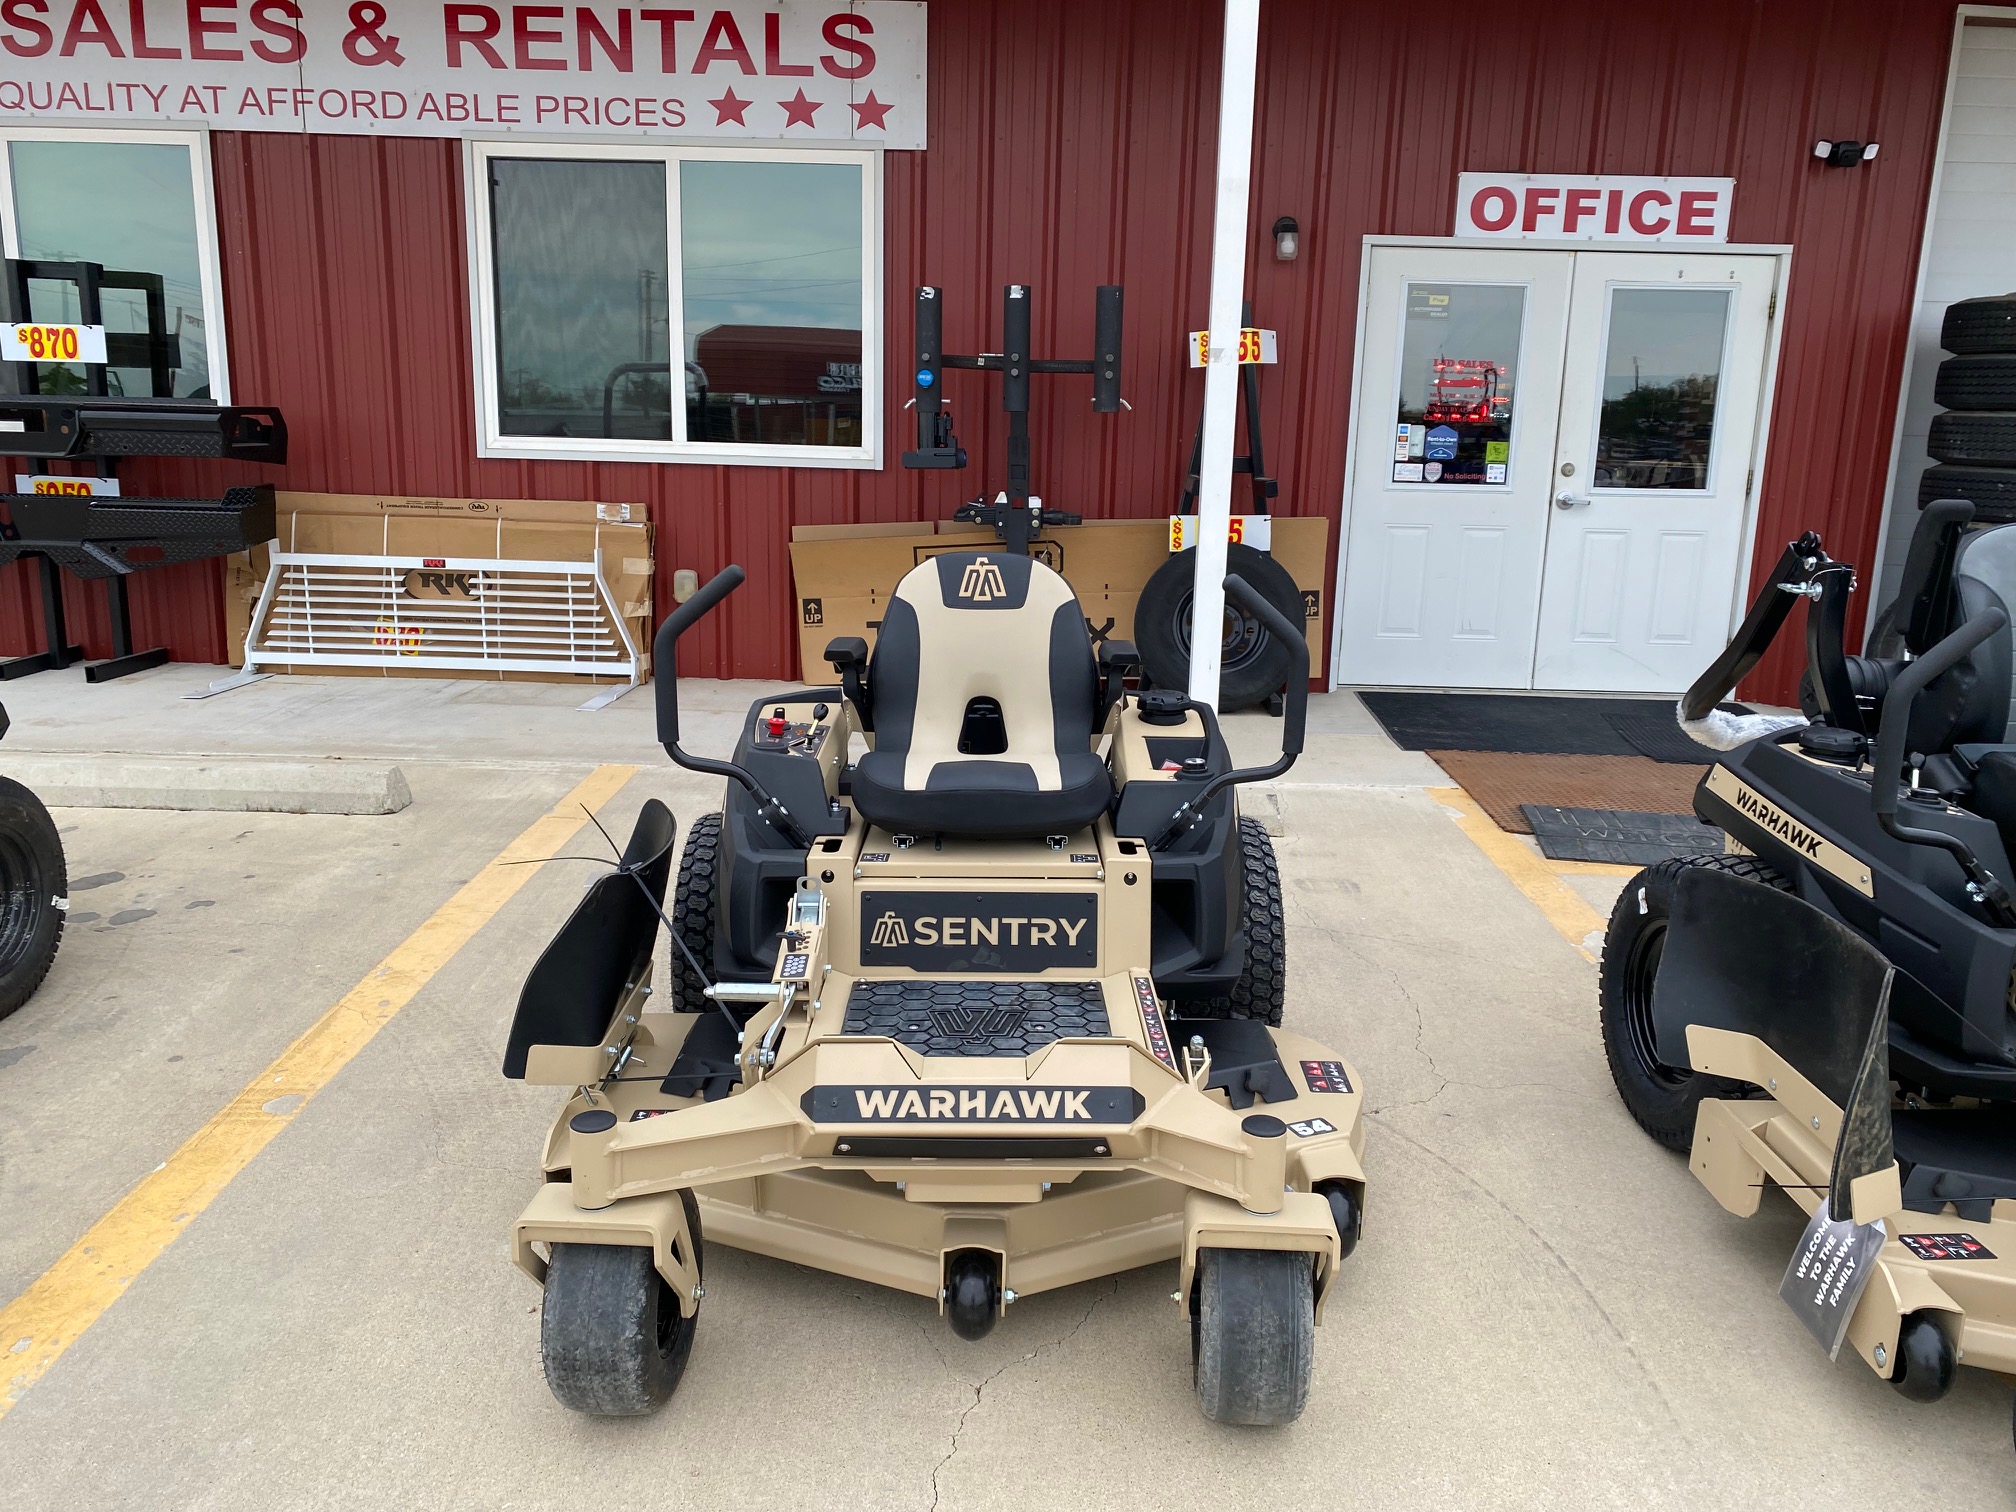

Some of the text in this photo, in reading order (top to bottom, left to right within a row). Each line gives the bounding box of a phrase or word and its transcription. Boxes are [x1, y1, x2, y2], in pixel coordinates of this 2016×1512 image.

[0, 0, 877, 80] SALES & RENTALS
[0, 81, 168, 112] QUALITY
[179, 85, 228, 114] AT
[535, 95, 686, 127] PRICES
[1470, 186, 1719, 236] OFFICE
[18, 326, 78, 359] $870
[1455, 473, 1486, 481] Soliciting
[805, 613, 822, 623] UP
[1736, 787, 1823, 859] WARHAWK
[914, 916, 1088, 946] SENTRY
[854, 1089, 1092, 1119] WARHAWK
[1289, 1119, 1333, 1136] 54
[1796, 1214, 1832, 1279] WELCOME
[1809, 1234, 1837, 1281] TO THE
[1814, 1233, 1856, 1306] WARHAWK
[1829, 1256, 1856, 1307] FAMILY
